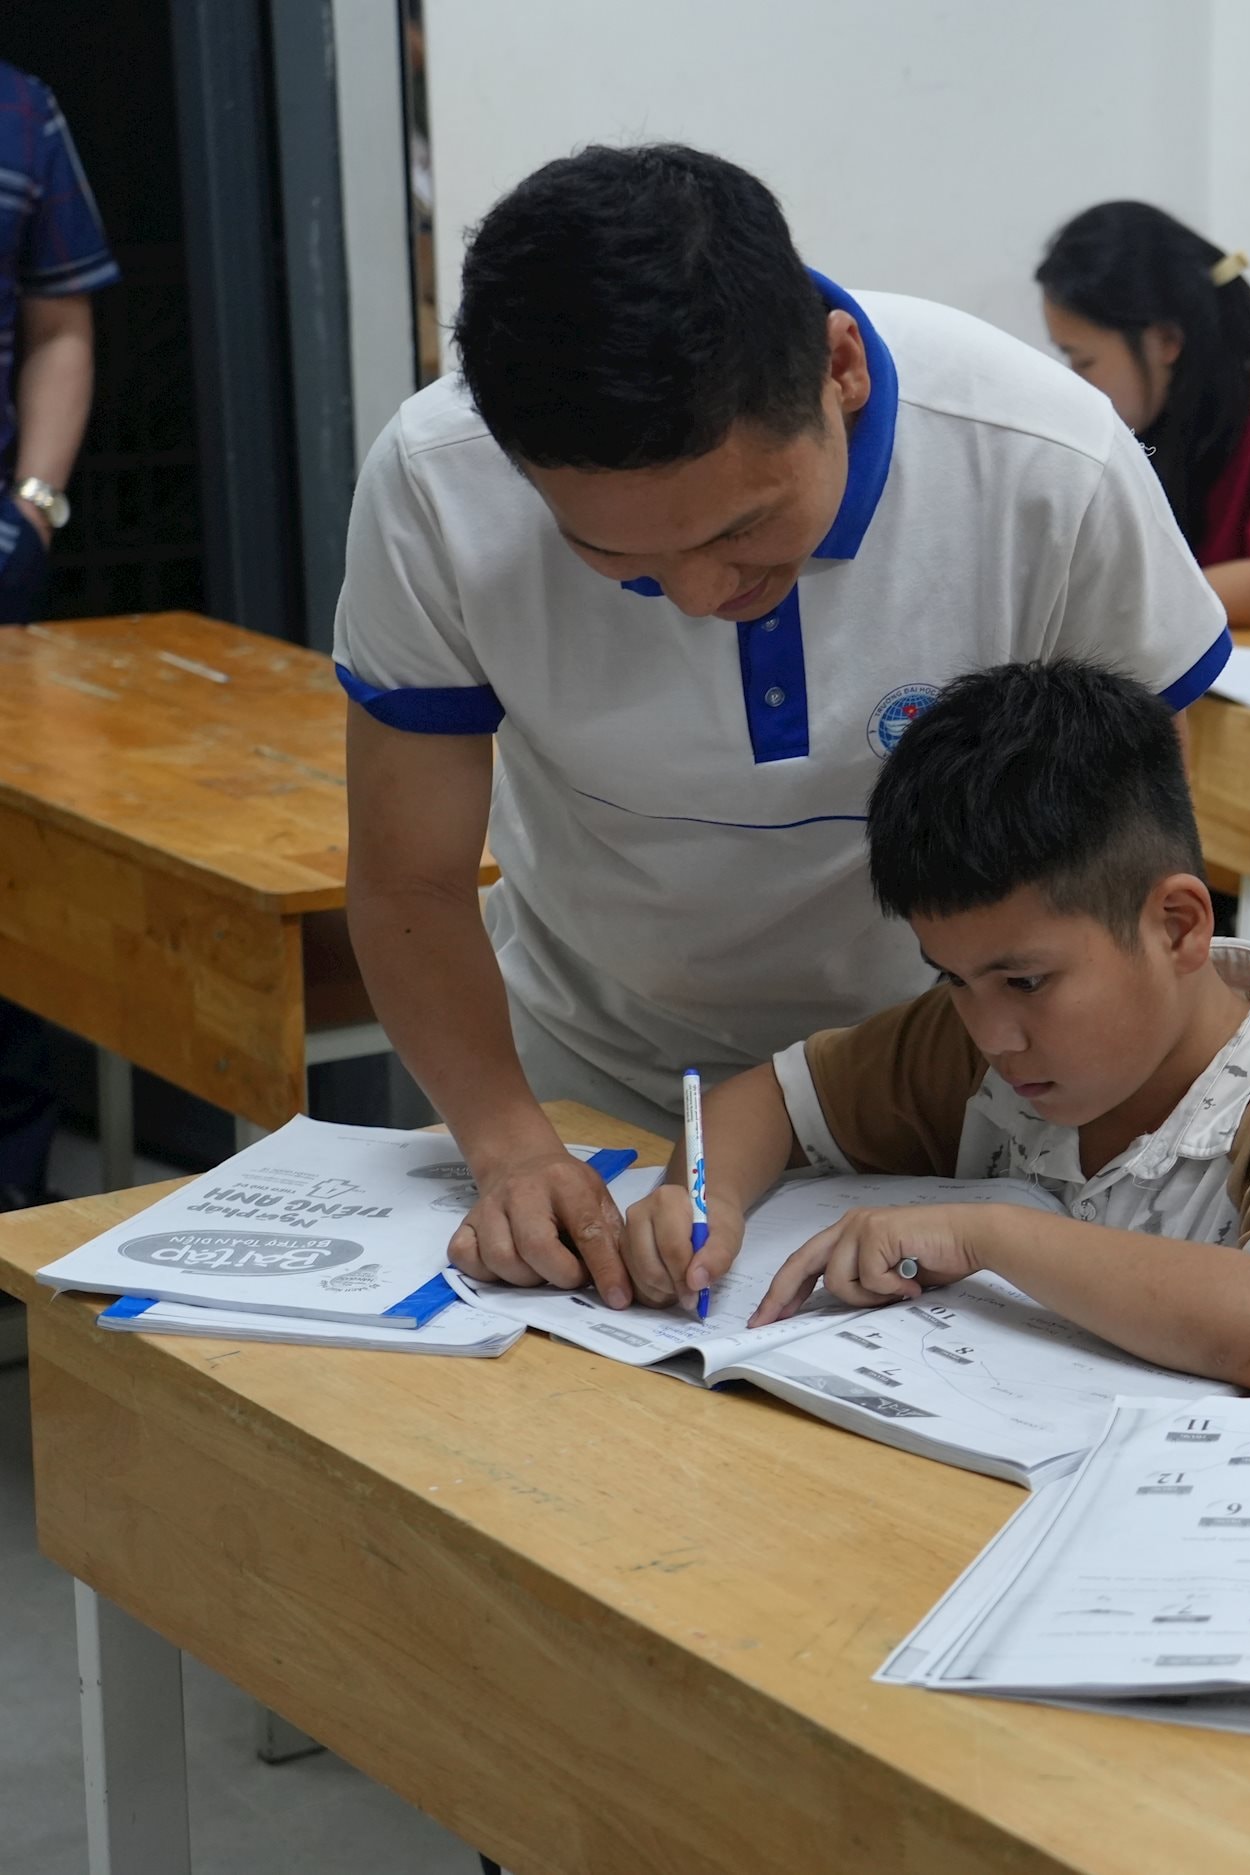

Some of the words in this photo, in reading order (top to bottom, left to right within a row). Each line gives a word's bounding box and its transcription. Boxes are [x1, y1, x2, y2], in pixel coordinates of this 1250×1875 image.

[202, 1187, 282, 1206] ANH
[305, 1179, 359, 1199] 4
[187, 1202, 259, 1217] pháp
[283, 1199, 393, 1218] TIẾNG
[256, 1213, 317, 1228] Ngữ
[151, 1244, 231, 1269] tập
[245, 1249, 331, 1269] Bài
[930, 1306, 956, 1319] 10
[955, 1346, 973, 1354] 8
[1187, 1419, 1210, 1430] 11
[1157, 1472, 1184, 1483] 12
[1225, 1502, 1242, 1515] 6
